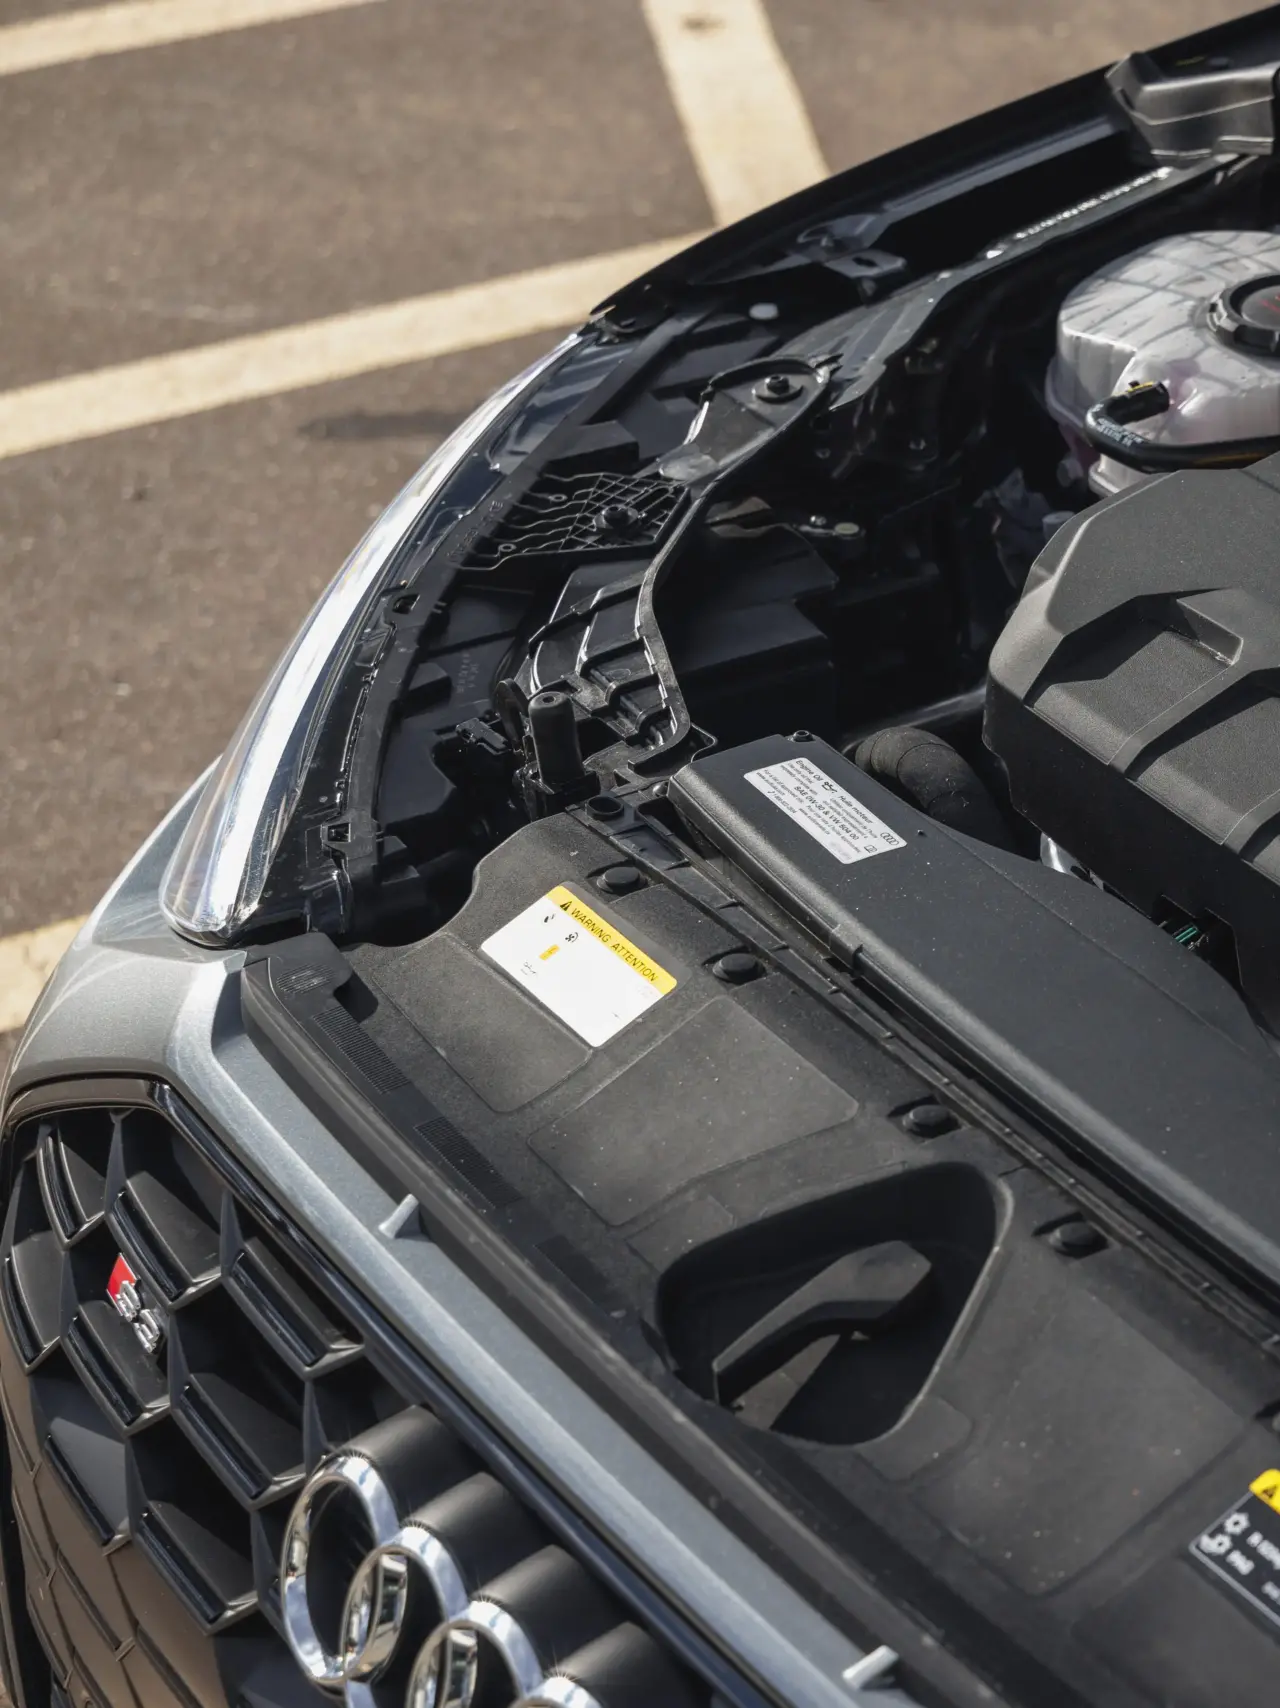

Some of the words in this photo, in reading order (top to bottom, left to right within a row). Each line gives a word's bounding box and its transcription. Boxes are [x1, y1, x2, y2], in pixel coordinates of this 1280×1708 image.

[796, 760, 814, 775] Engine
[794, 786, 808, 796] SAE
[806, 796, 825, 810] 0W-30
[829, 815, 841, 824] VW
[839, 824, 851, 833] 504
[838, 796, 853, 807] Huile
[852, 807, 873, 823] moteur
[571, 907, 611, 943] WARNING
[611, 943, 658, 982] ATTENTION
